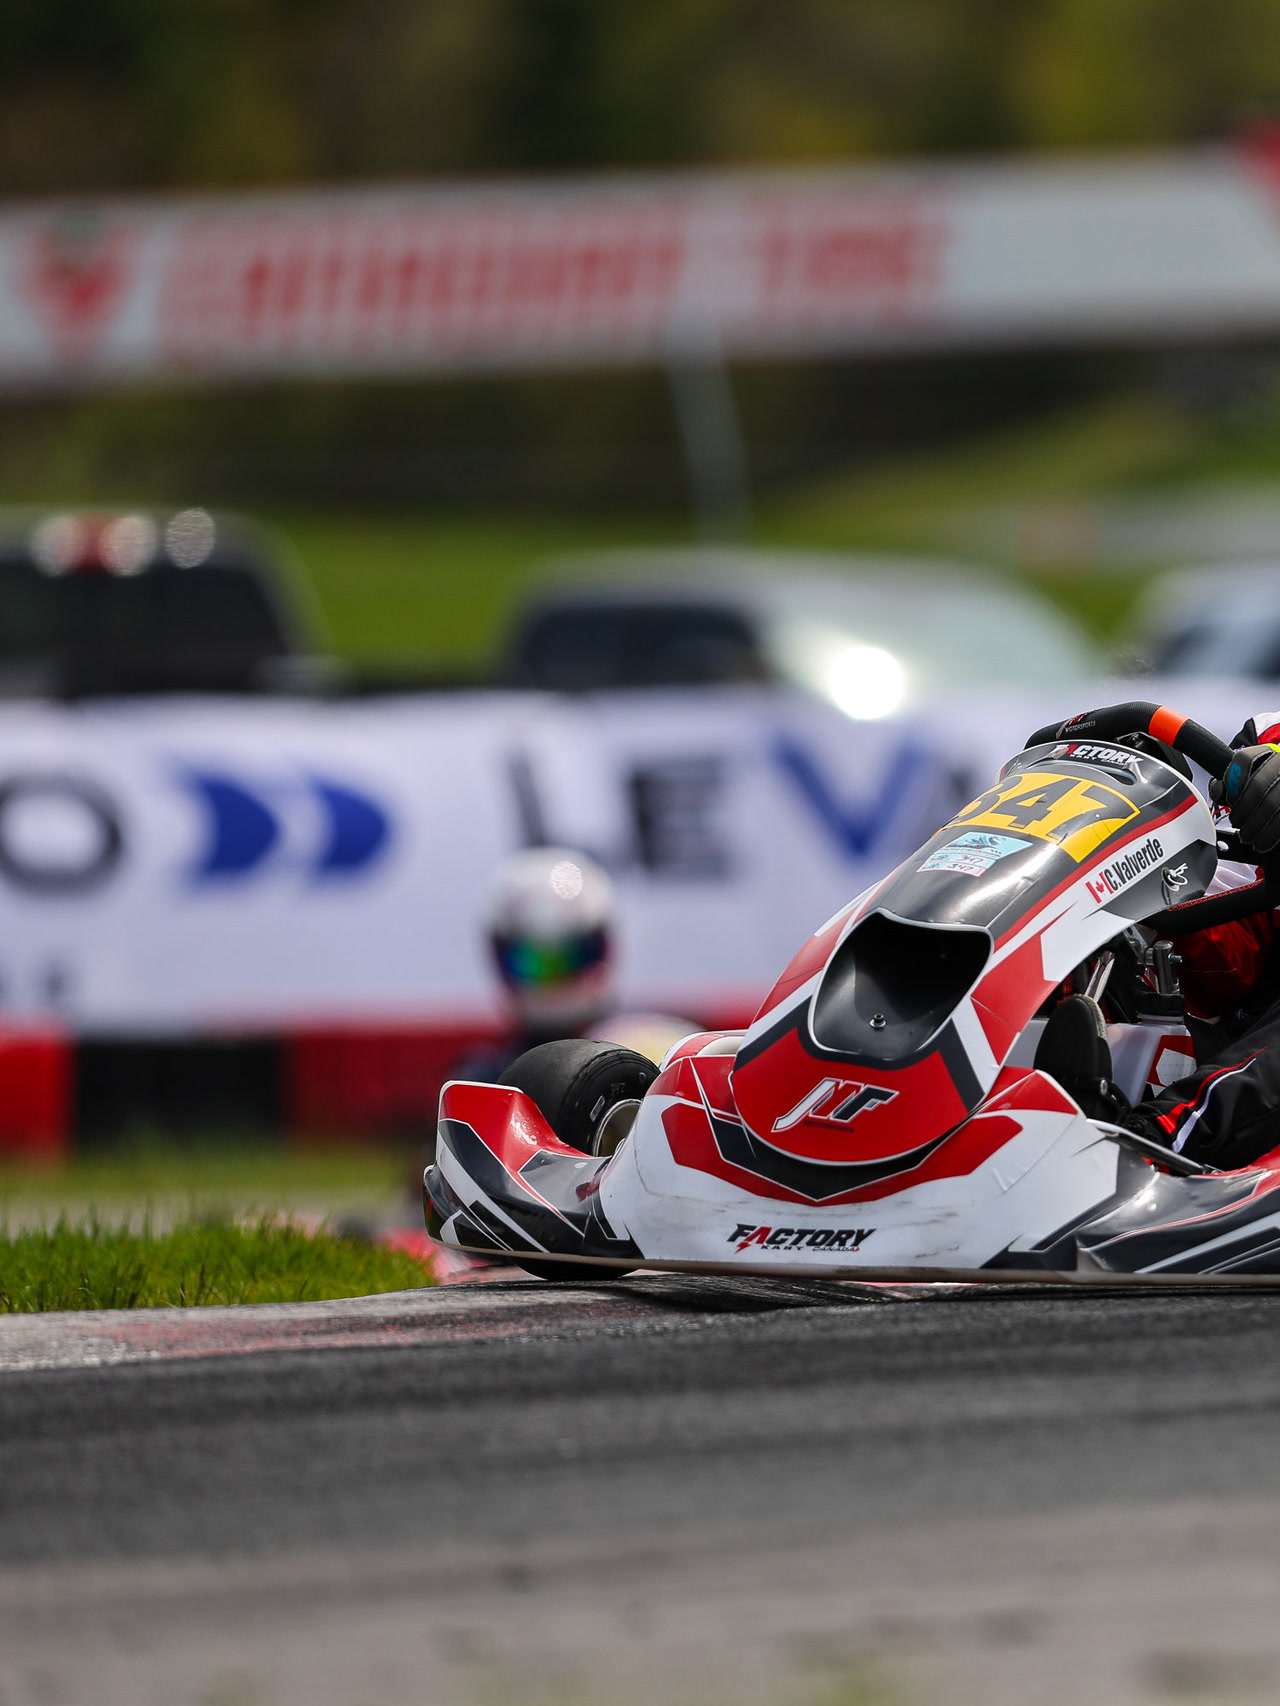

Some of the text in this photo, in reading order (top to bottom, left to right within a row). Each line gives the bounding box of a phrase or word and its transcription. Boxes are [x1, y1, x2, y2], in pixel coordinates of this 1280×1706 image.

[1050, 744, 1144, 764] FACTORY
[946, 775, 1137, 841] 347
[727, 1223, 877, 1254] FACTORY
